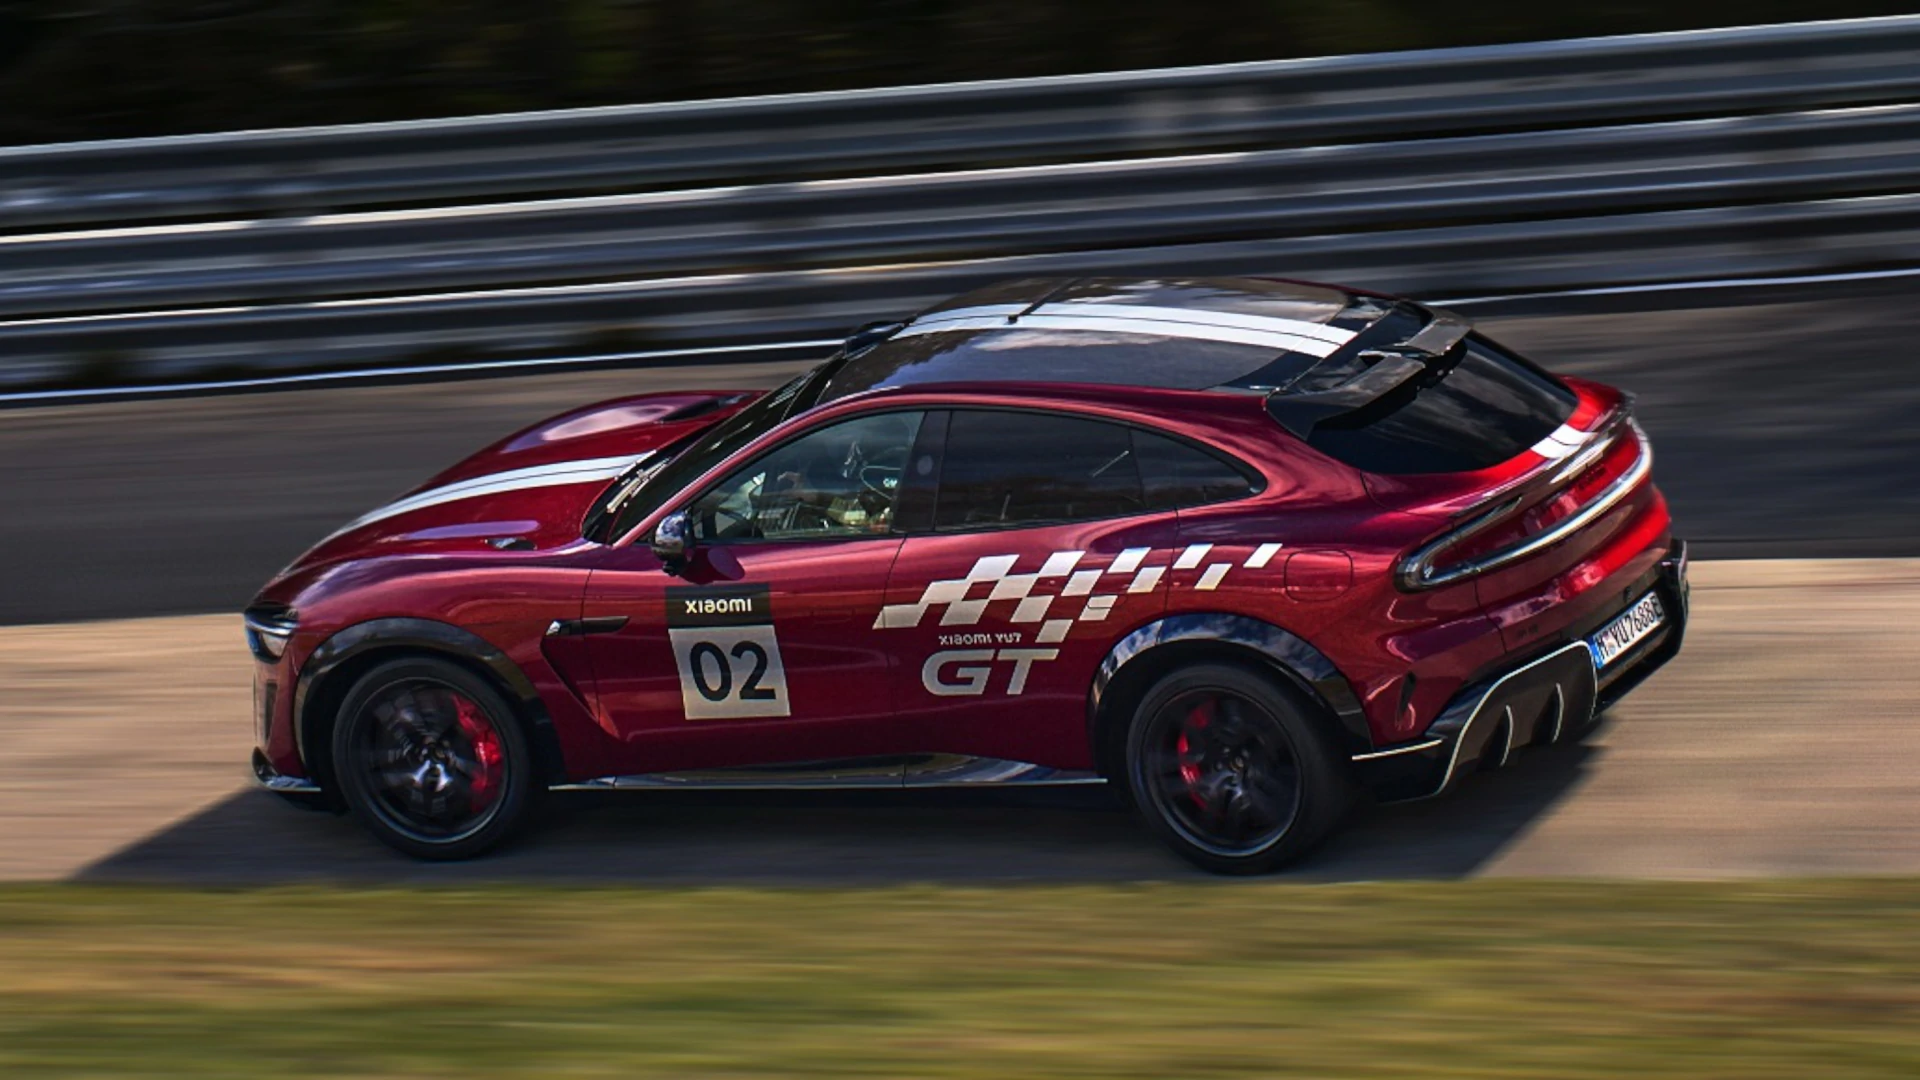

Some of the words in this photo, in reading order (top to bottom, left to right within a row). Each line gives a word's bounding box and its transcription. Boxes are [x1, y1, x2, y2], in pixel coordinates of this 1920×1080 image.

[995, 632, 1023, 643] YU7
[690, 640, 777, 702] 02
[921, 648, 1060, 696] GT
